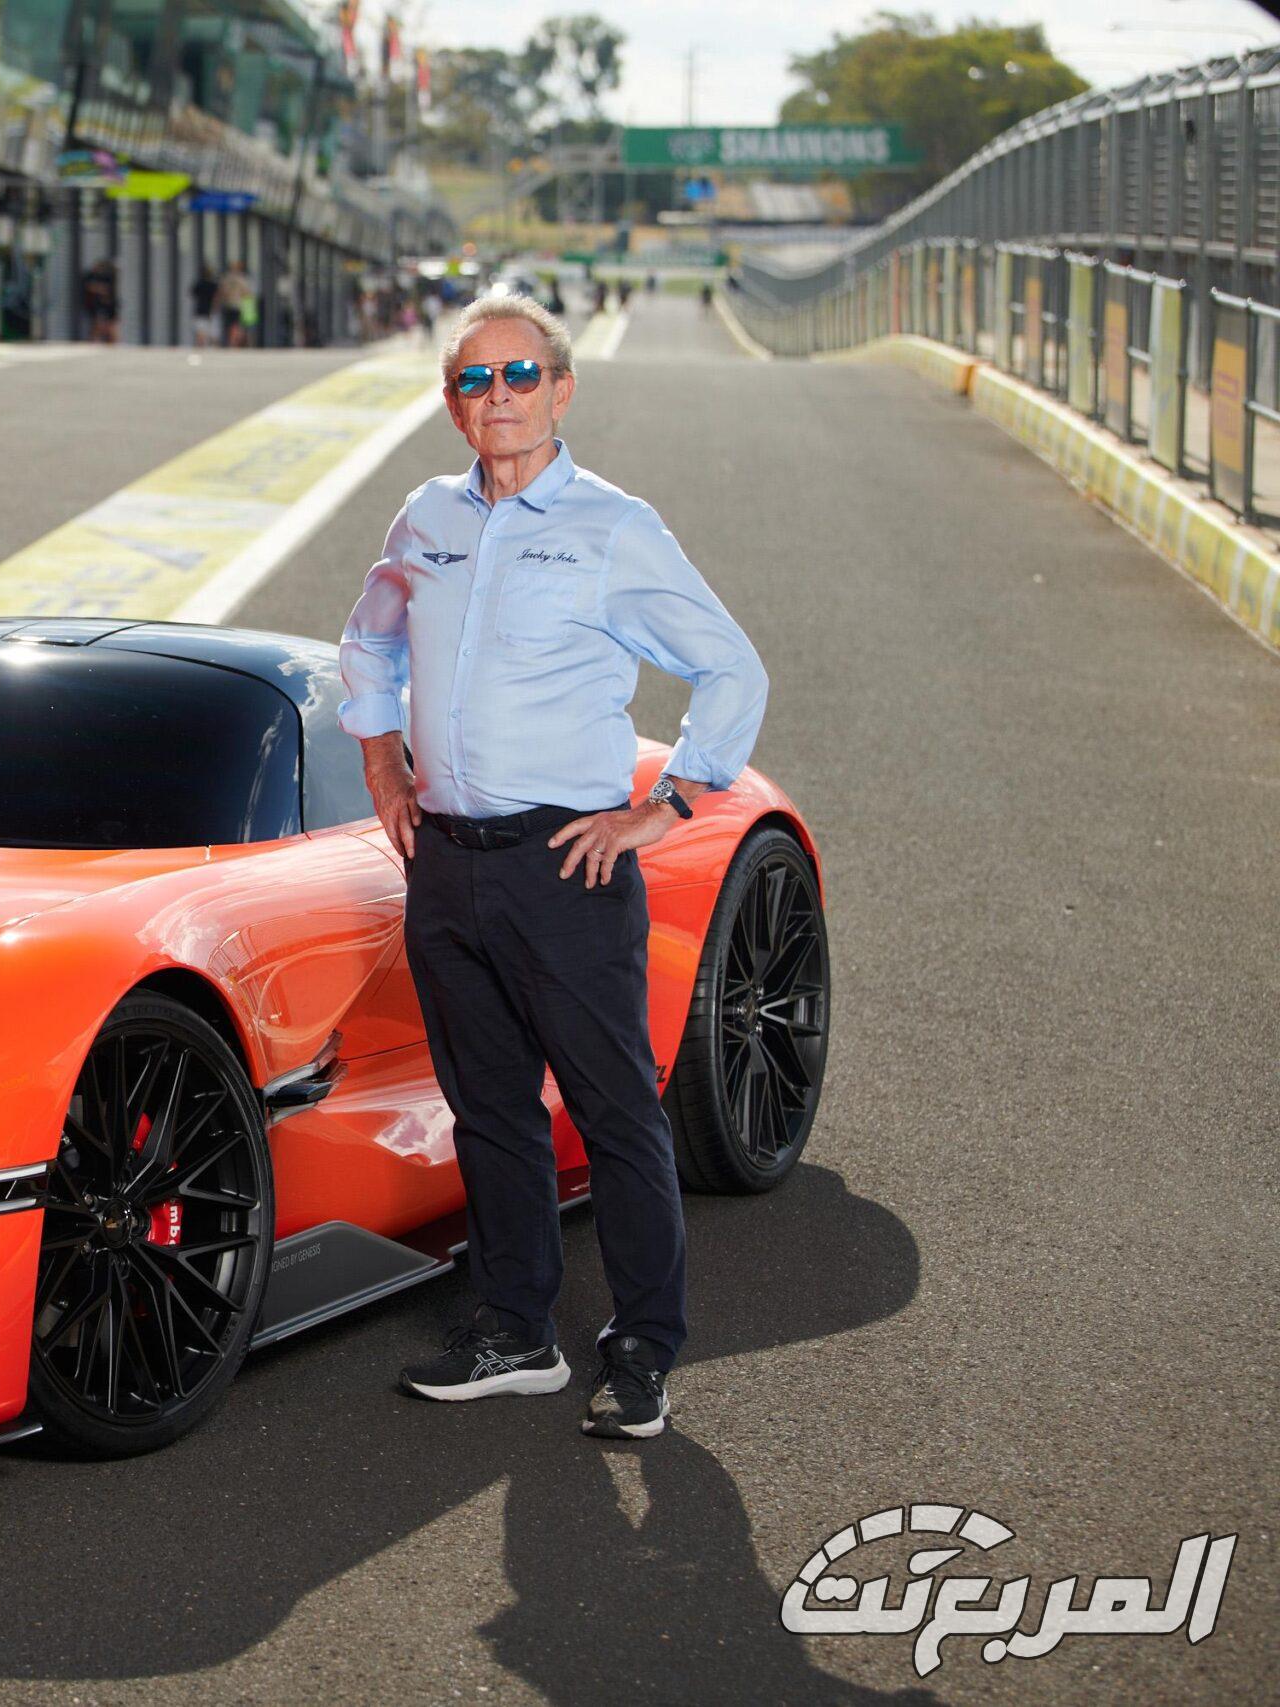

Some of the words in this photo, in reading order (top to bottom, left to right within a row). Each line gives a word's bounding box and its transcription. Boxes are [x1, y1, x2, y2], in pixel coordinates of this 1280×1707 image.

[721, 128, 890, 164] SHANNONS
[516, 548, 551, 564] Jacky
[297, 1242, 321, 1263] GENESIS
